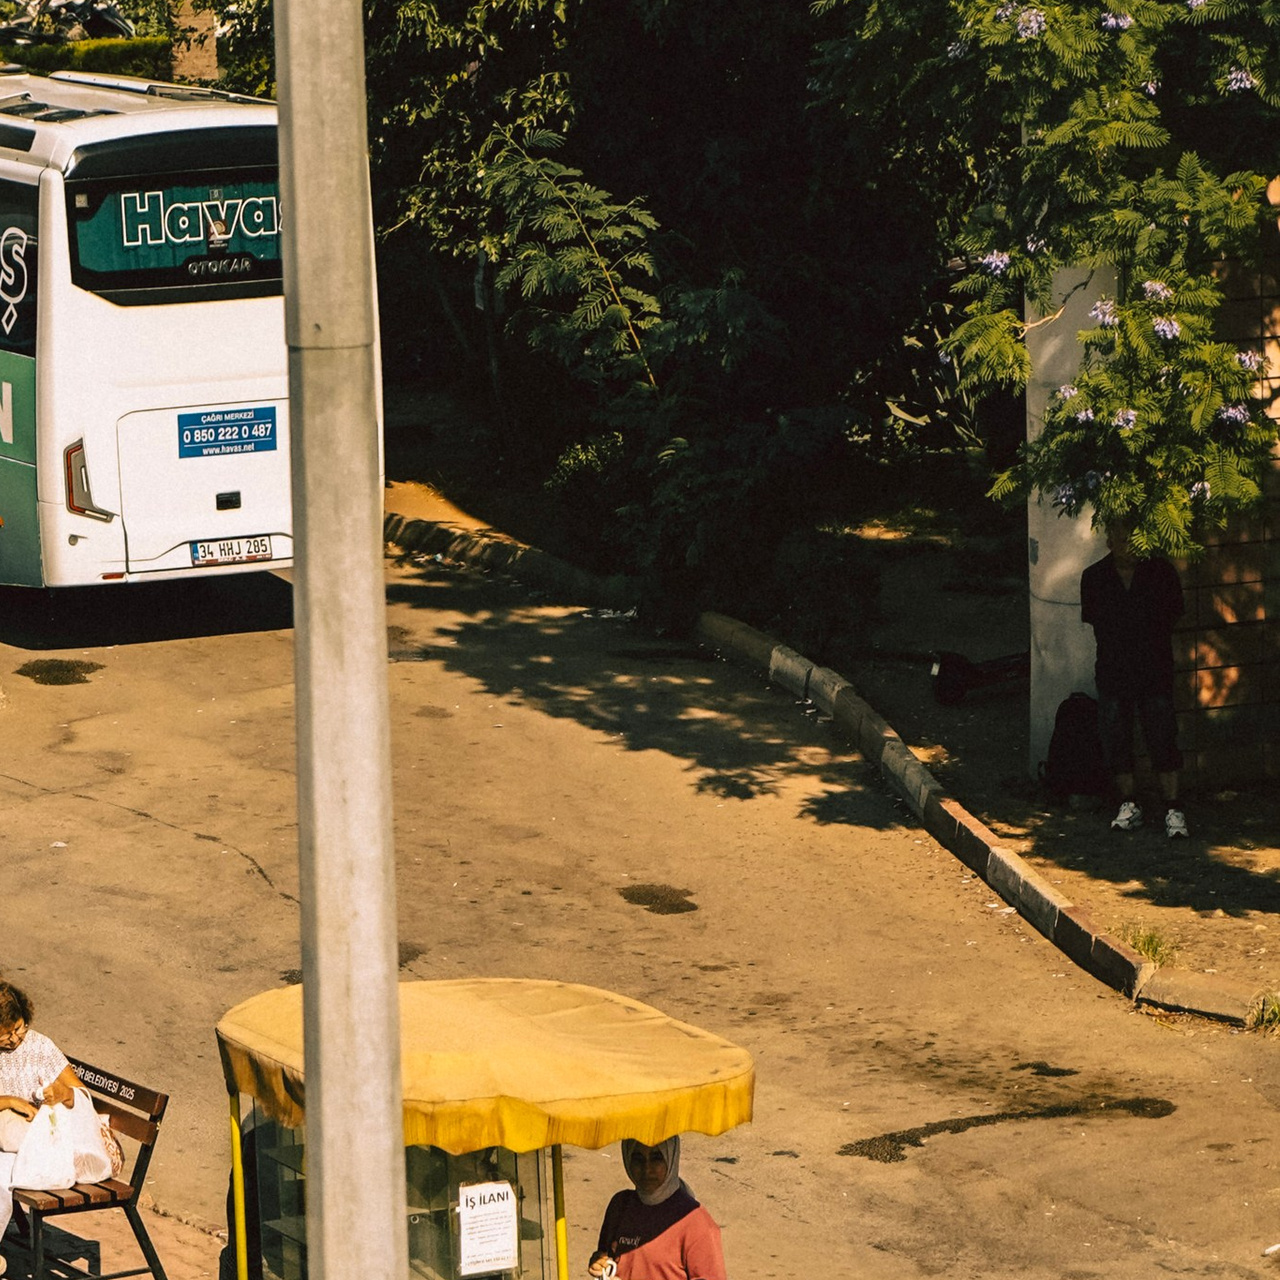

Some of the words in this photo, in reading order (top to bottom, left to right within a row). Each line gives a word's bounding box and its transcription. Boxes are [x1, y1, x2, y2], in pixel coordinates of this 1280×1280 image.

[188, 258, 252, 275] OTOKAR
[201, 413, 223, 424] ÇAĞRI
[224, 410, 254, 421] MERKEZİ
[184, 431, 191, 443] 0
[194, 429, 215, 442] 850
[218, 427, 238, 440] 222
[242, 426, 249, 438] 0
[252, 424, 272, 436] 487
[203, 443, 255, 455] www.havas.net
[200, 544, 214, 558] 34
[219, 541, 241, 557] HHJ
[246, 539, 267, 554] 285
[84, 1070, 120, 1093] BELEDİYESİ
[120, 1085, 135, 1100] 2025
[466, 1195, 476, 1210] İŞ
[479, 1191, 509, 1206] İLANI
